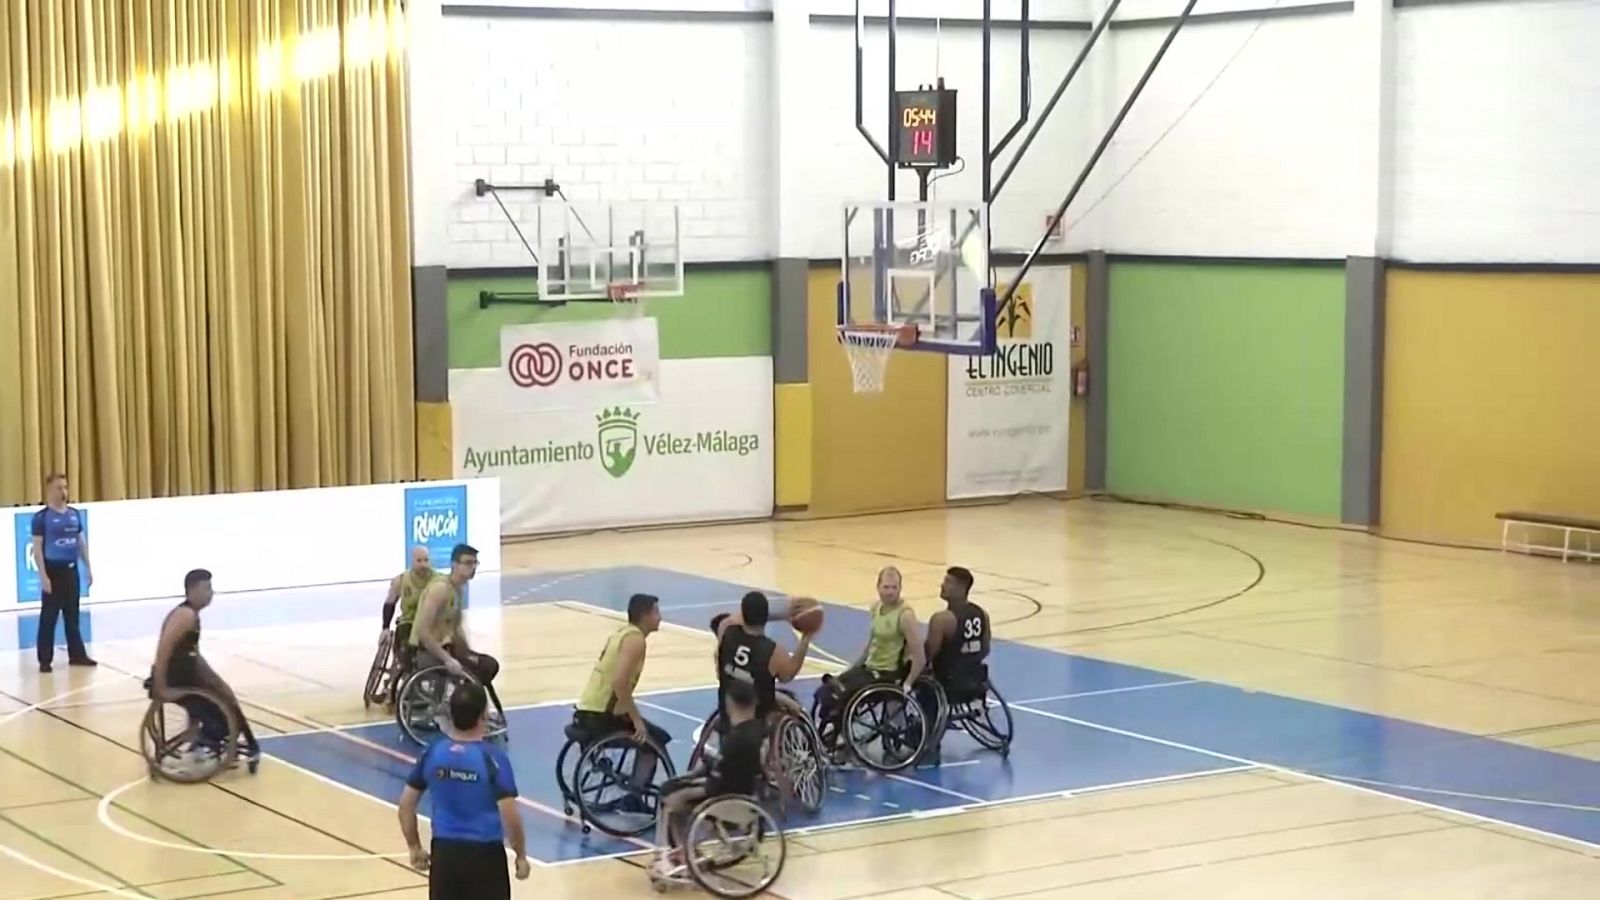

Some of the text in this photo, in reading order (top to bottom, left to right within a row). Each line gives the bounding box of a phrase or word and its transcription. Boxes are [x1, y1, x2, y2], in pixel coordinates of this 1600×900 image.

[913, 130, 932, 155] 14
[569, 342, 633, 357] Fundación
[990, 342, 1053, 378] INGENIO
[568, 359, 634, 381] ONCE
[463, 430, 760, 474] Ayuntamiento Vélez-Málaga
[964, 617, 981, 639] 33
[734, 645, 751, 666] 5
